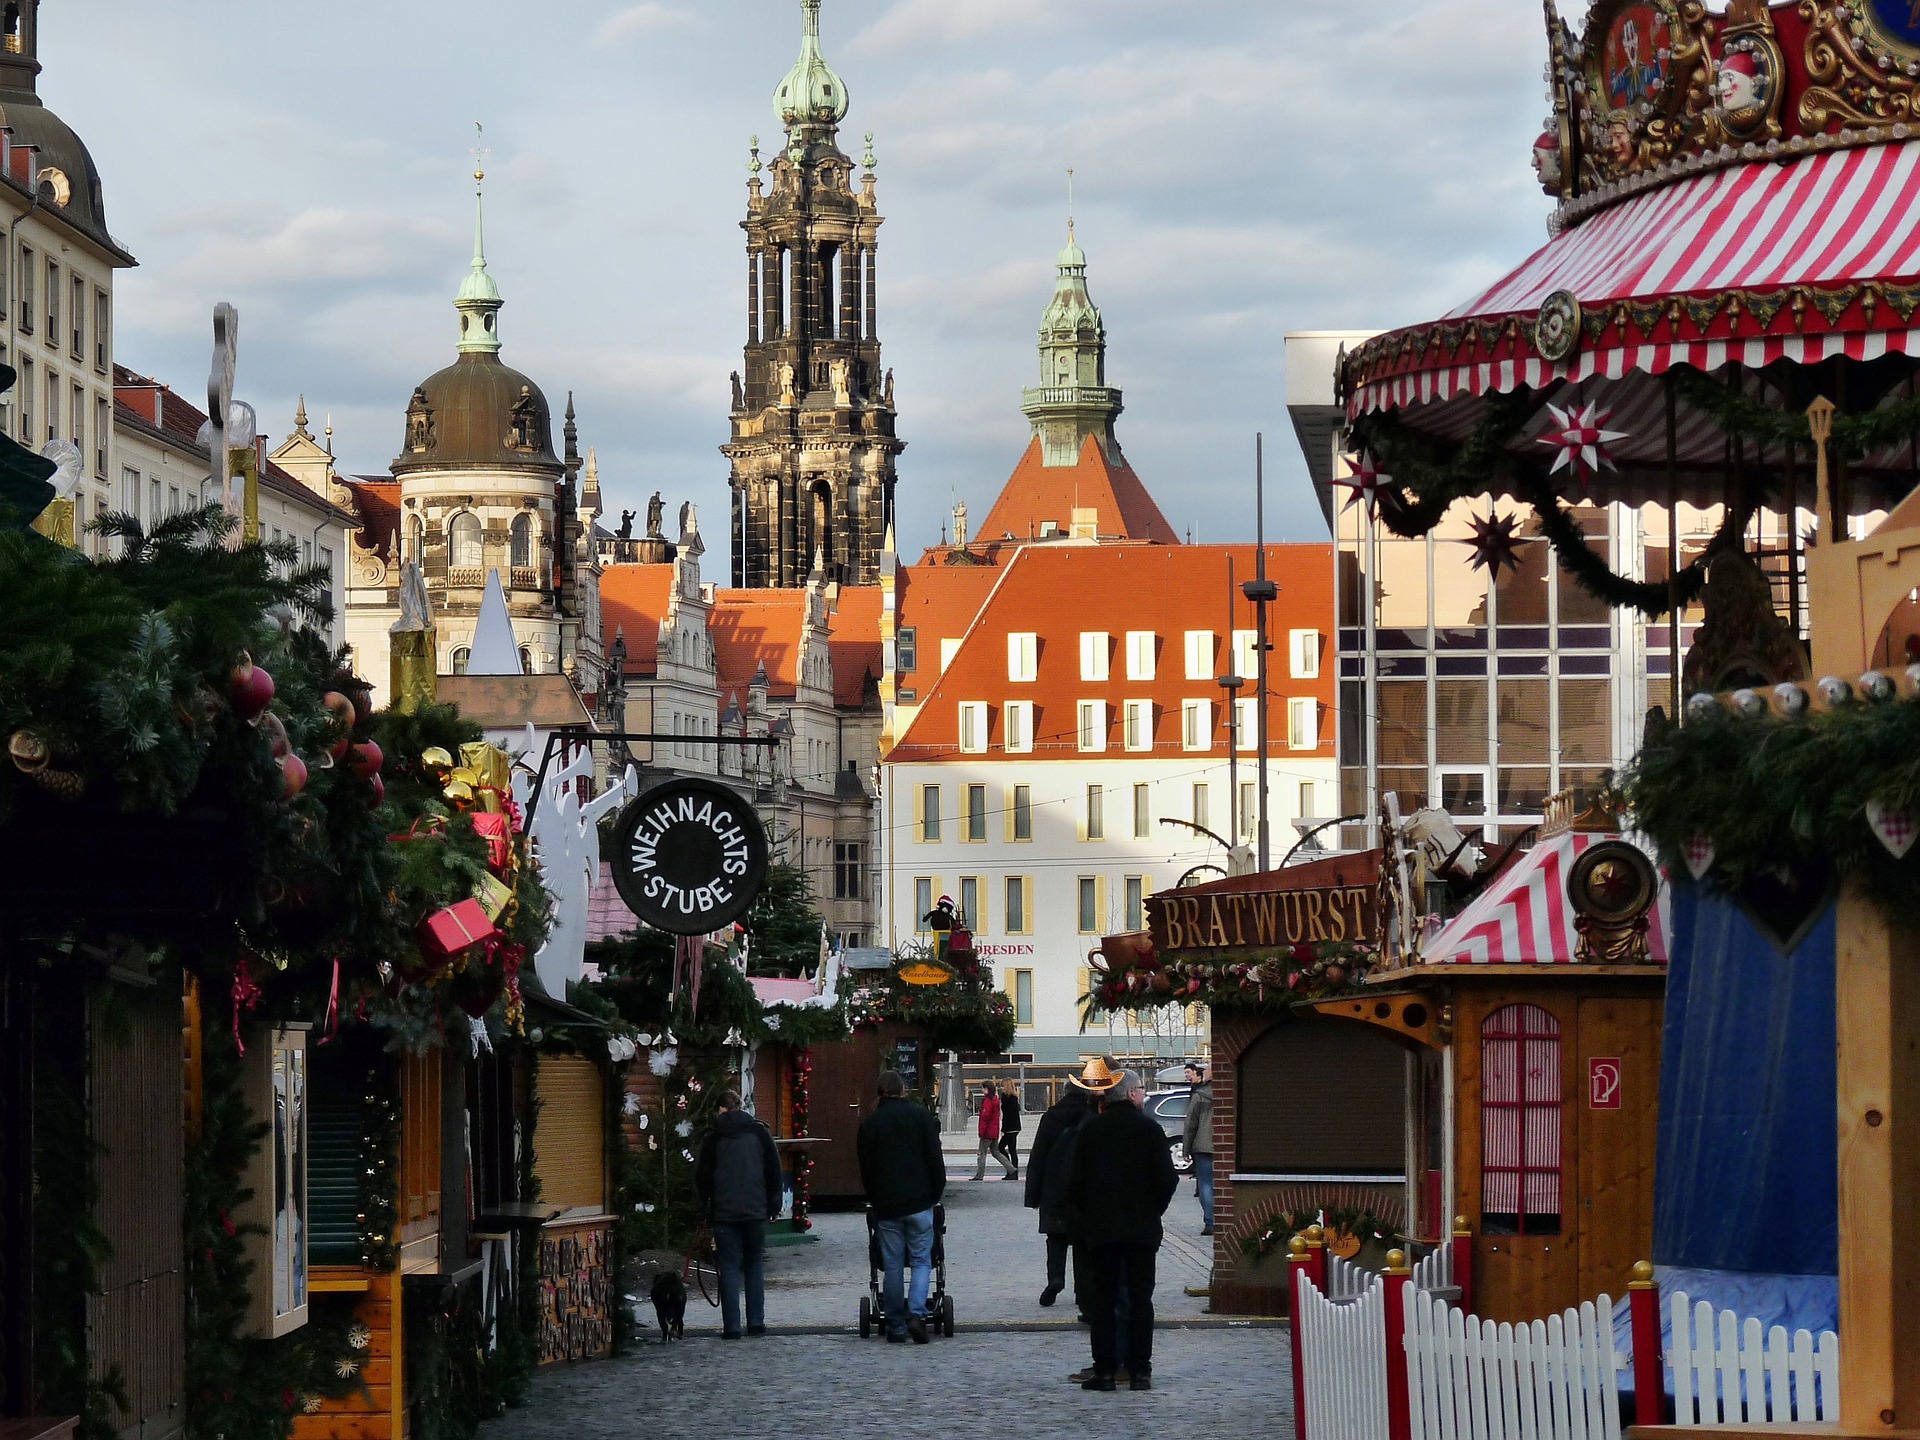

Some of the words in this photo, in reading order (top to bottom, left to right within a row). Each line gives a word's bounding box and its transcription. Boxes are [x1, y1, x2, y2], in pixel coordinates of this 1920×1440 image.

[631, 797, 748, 876] WEIHNACHTS
[643, 875, 733, 914] STUBE
[1162, 889, 1368, 949] BRATWURST
